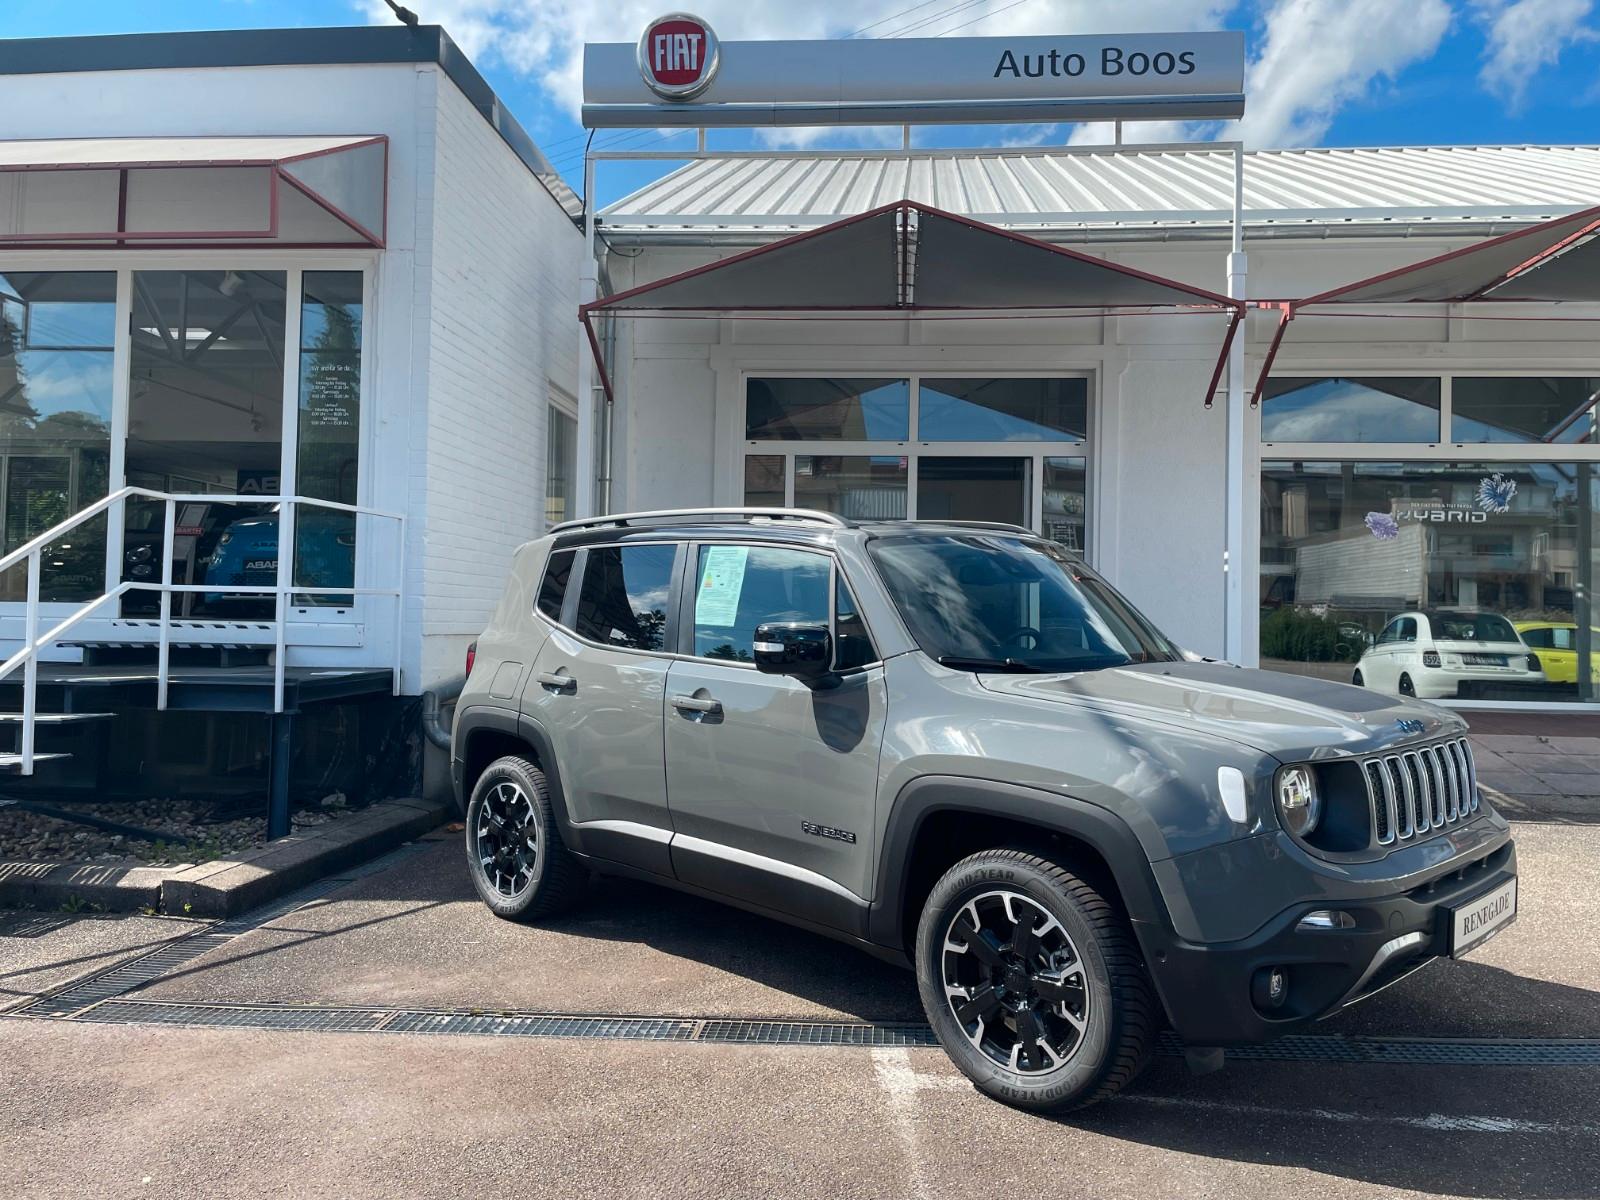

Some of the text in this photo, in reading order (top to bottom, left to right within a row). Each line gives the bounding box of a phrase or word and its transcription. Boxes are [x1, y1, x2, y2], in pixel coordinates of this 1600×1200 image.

[654, 32, 703, 72] FIAT
[994, 47, 1196, 78] Auto Boos
[801, 820, 857, 844] RENEGADE
[1463, 892, 1510, 936] RENEGADE
